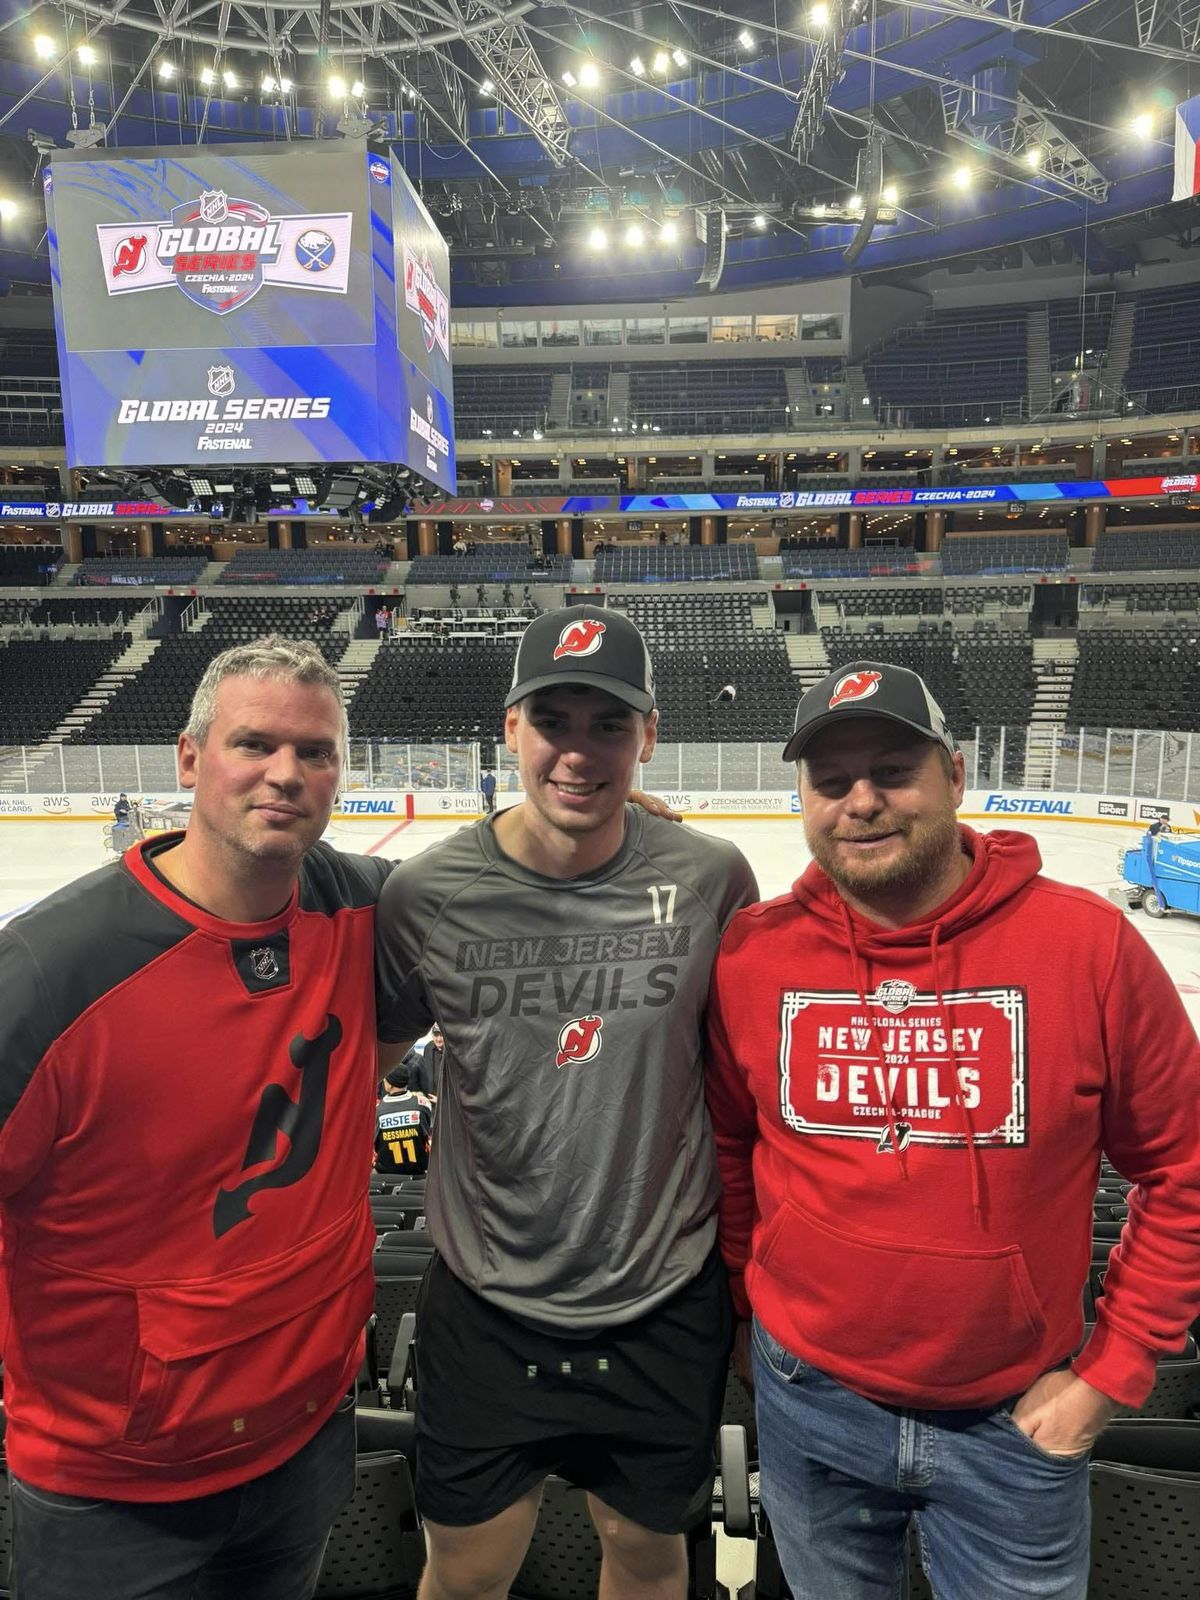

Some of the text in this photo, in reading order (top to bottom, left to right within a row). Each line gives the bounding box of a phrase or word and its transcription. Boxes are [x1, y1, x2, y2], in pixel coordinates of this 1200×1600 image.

[158, 225, 279, 257] GLOBAL
[173, 253, 257, 273] SERIES
[202, 283, 239, 294] FASTENAL
[118, 397, 332, 424] GLOBAL SERIES
[205, 422, 244, 434] 2024
[197, 436, 253, 450] FASTENAL
[736, 496, 779, 507] FASTENAL
[796, 492, 852, 507] GLOBAL
[853, 490, 913, 505] SERIES
[1, 505, 45, 516] FASTENAL
[62, 503, 115, 516] GLOBAL
[43, 796, 70, 807] aws
[664, 794, 691, 805] aws
[985, 795, 1073, 815] FASTENAL
[1100, 807, 1126, 815] SPORT
[646, 884, 677, 924] 17
[463, 929, 684, 970] NEW JERSEY
[470, 963, 678, 1019] DEVILS
[877, 987, 915, 997] GLOBAL
[850, 1016, 869, 1026] NHL
[908, 1017, 942, 1028] SERIES
[818, 1026, 984, 1053] NEW JERSEY
[884, 1054, 910, 1065] 2024
[816, 1063, 981, 1109] DEVILS
[381, 1114, 410, 1128] ERSTE
[383, 1128, 419, 1142] RESSMANN
[388, 1139, 417, 1164] 11
